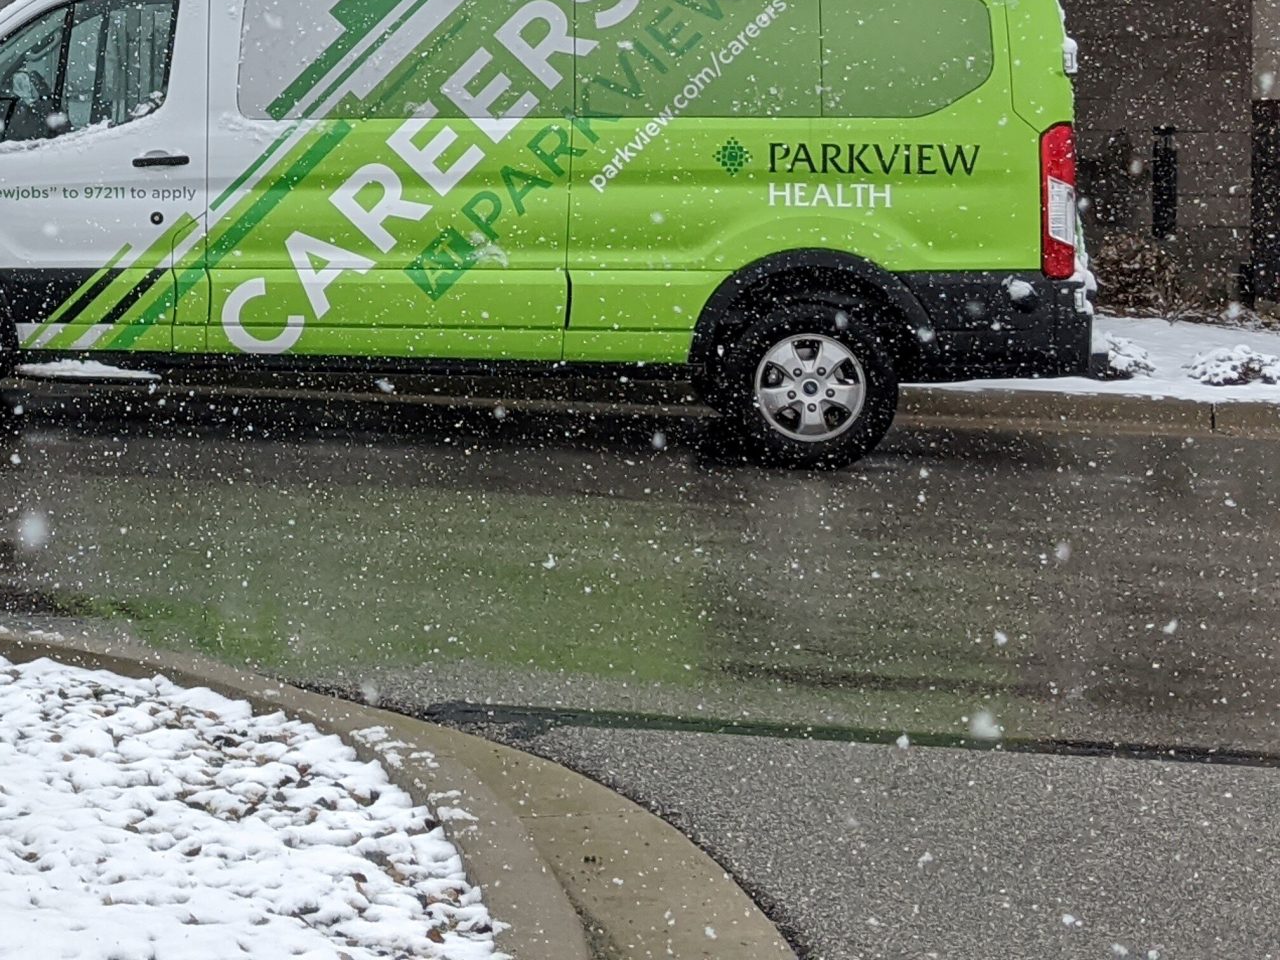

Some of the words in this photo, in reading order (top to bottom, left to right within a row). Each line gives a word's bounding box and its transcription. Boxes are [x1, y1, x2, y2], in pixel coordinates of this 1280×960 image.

[768, 142, 981, 176] PARKVIEW
[62, 187, 79, 199] to
[84, 186, 125, 199] 97211
[130, 187, 147, 199] to
[151, 186, 197, 202] apply
[768, 182, 892, 208] HEALTH
[419, 240, 465, 291] AT
